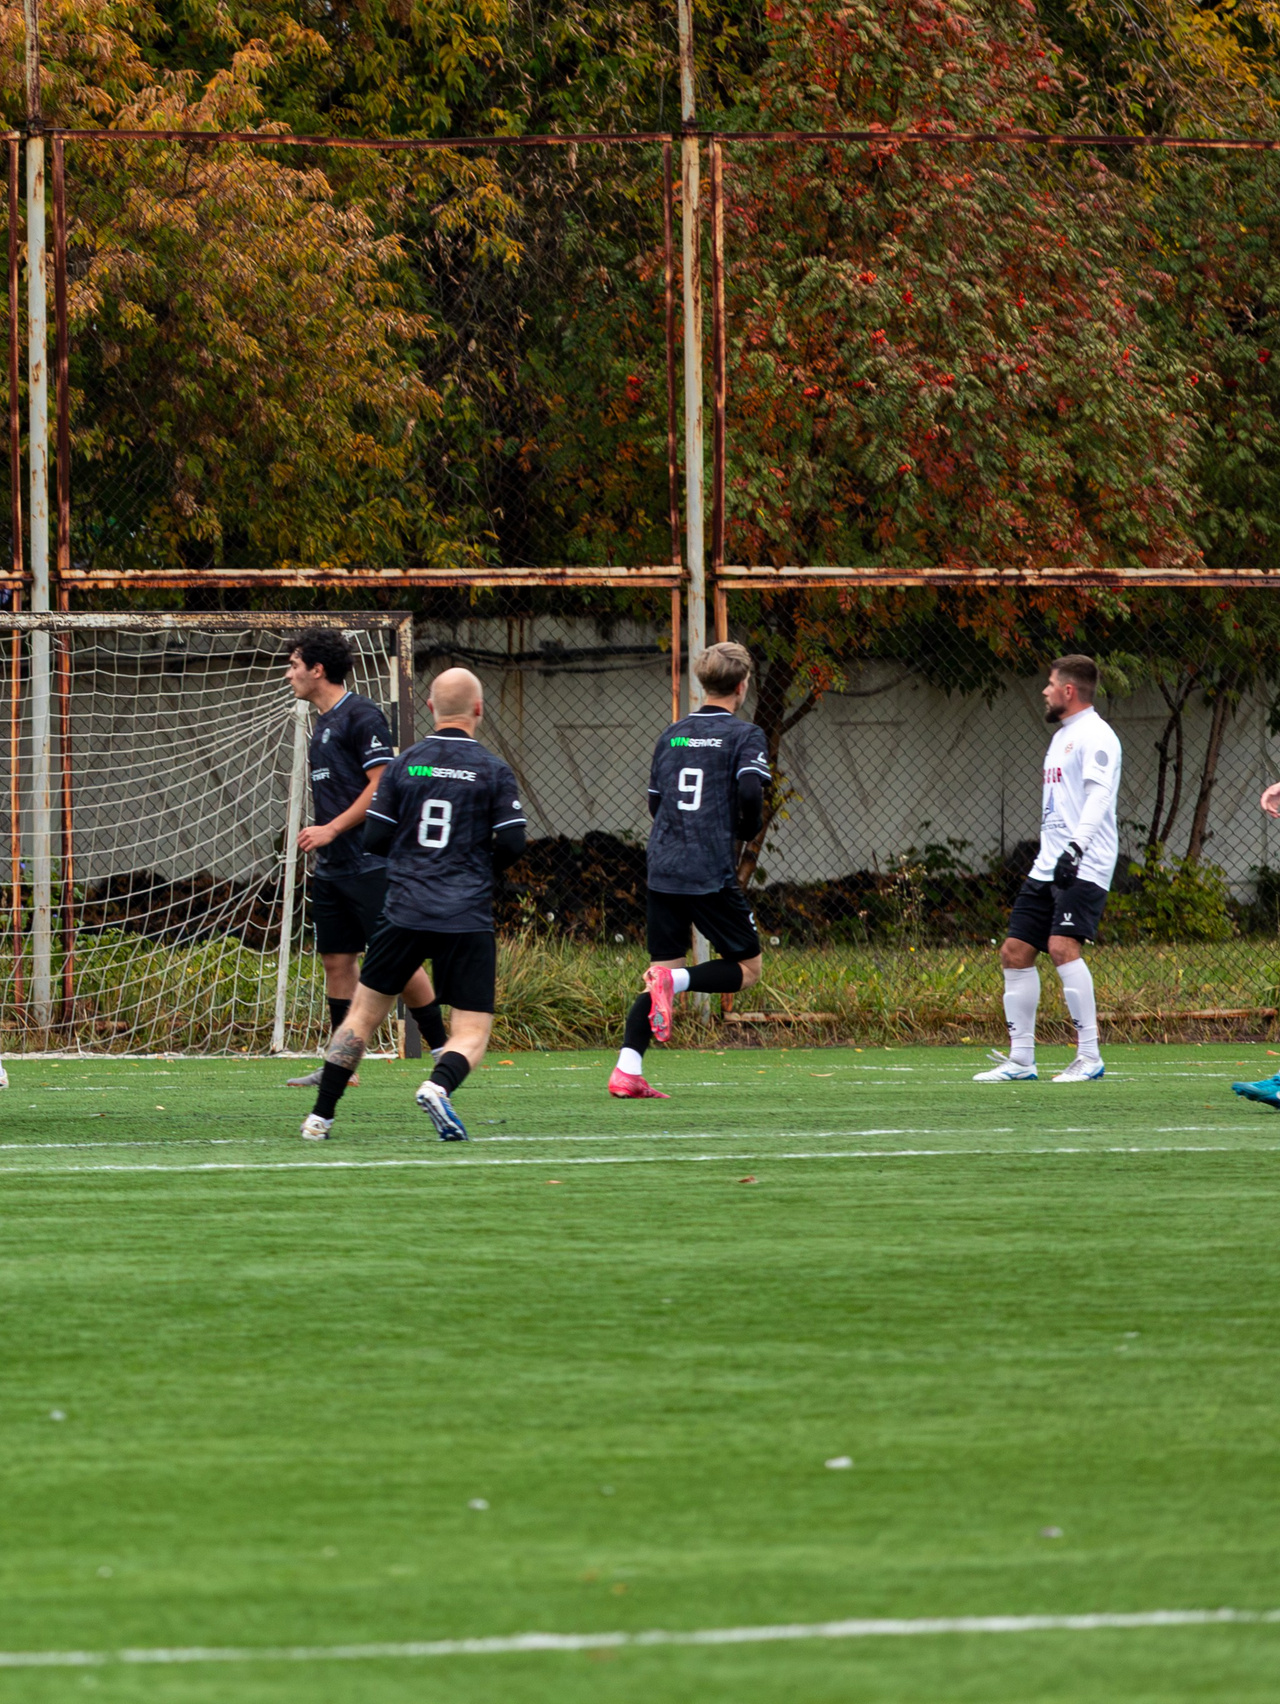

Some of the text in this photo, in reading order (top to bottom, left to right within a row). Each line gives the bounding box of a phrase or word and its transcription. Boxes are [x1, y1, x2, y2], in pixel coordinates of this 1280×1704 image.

[407, 764, 478, 782] VINSERVICE
[677, 767, 704, 811] 9
[417, 798, 453, 848] 8
